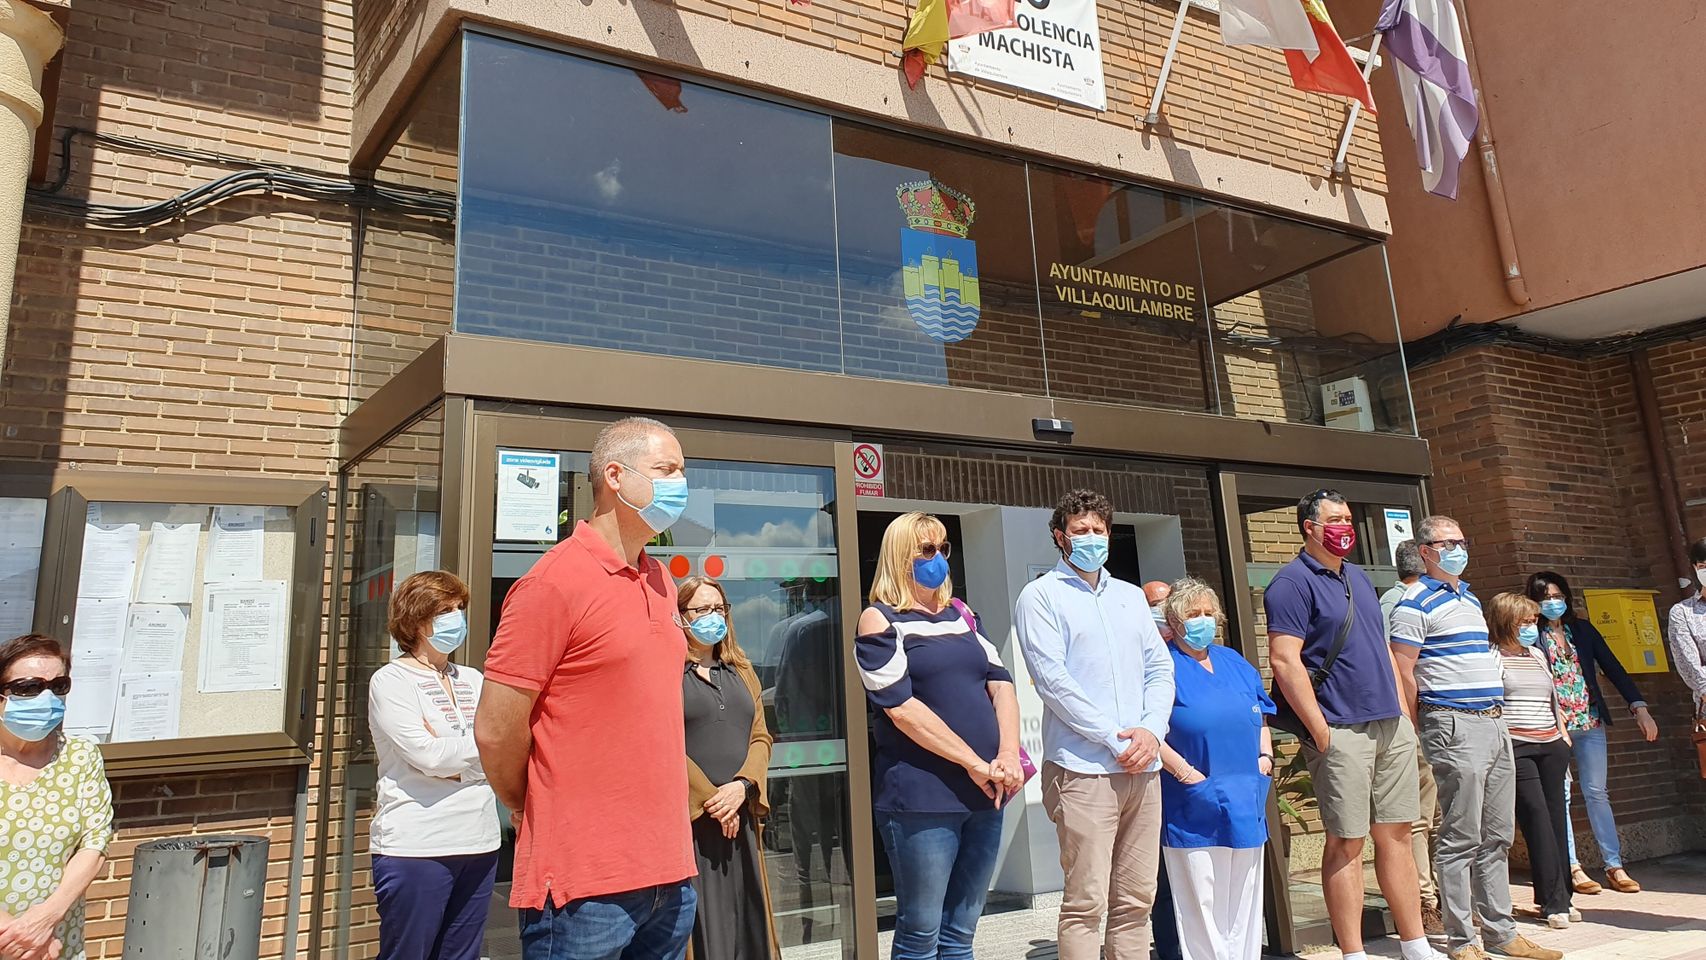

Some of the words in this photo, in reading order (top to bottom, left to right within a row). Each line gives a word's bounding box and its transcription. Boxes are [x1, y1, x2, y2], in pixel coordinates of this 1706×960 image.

[978, 31, 1075, 71] MACHISTA
[1017, 13, 1095, 51] OLENCIA
[1049, 262, 1171, 297] AYUNTAMIENTO
[1174, 284, 1196, 302] DE
[1055, 285, 1194, 322] VILLAQUILAMBRE
